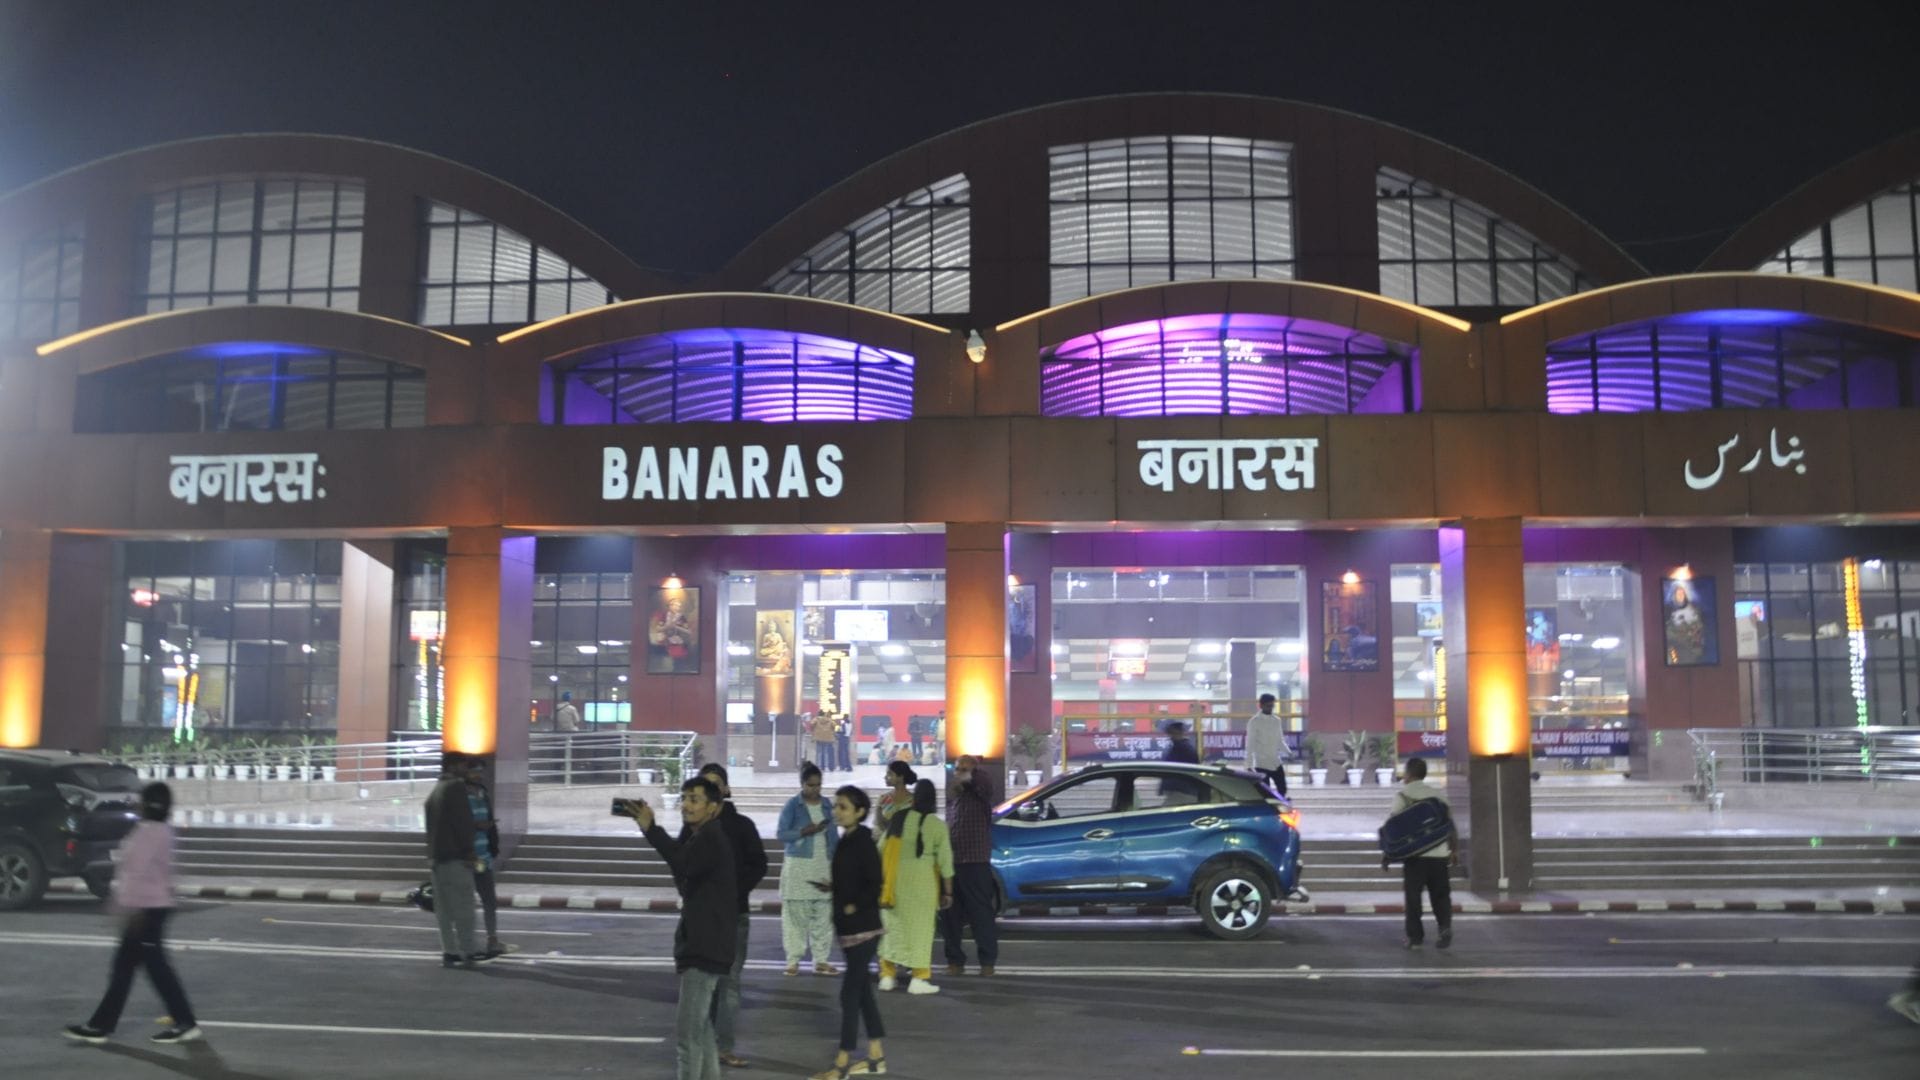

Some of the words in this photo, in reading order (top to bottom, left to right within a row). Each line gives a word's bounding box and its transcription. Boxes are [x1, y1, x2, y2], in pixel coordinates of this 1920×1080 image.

[602, 445, 843, 501] BANARAS
[1137, 438, 1318, 492] बनारस
[1684, 428, 1806, 490] بنارس
[1563, 732, 1614, 744] PROTECTION
